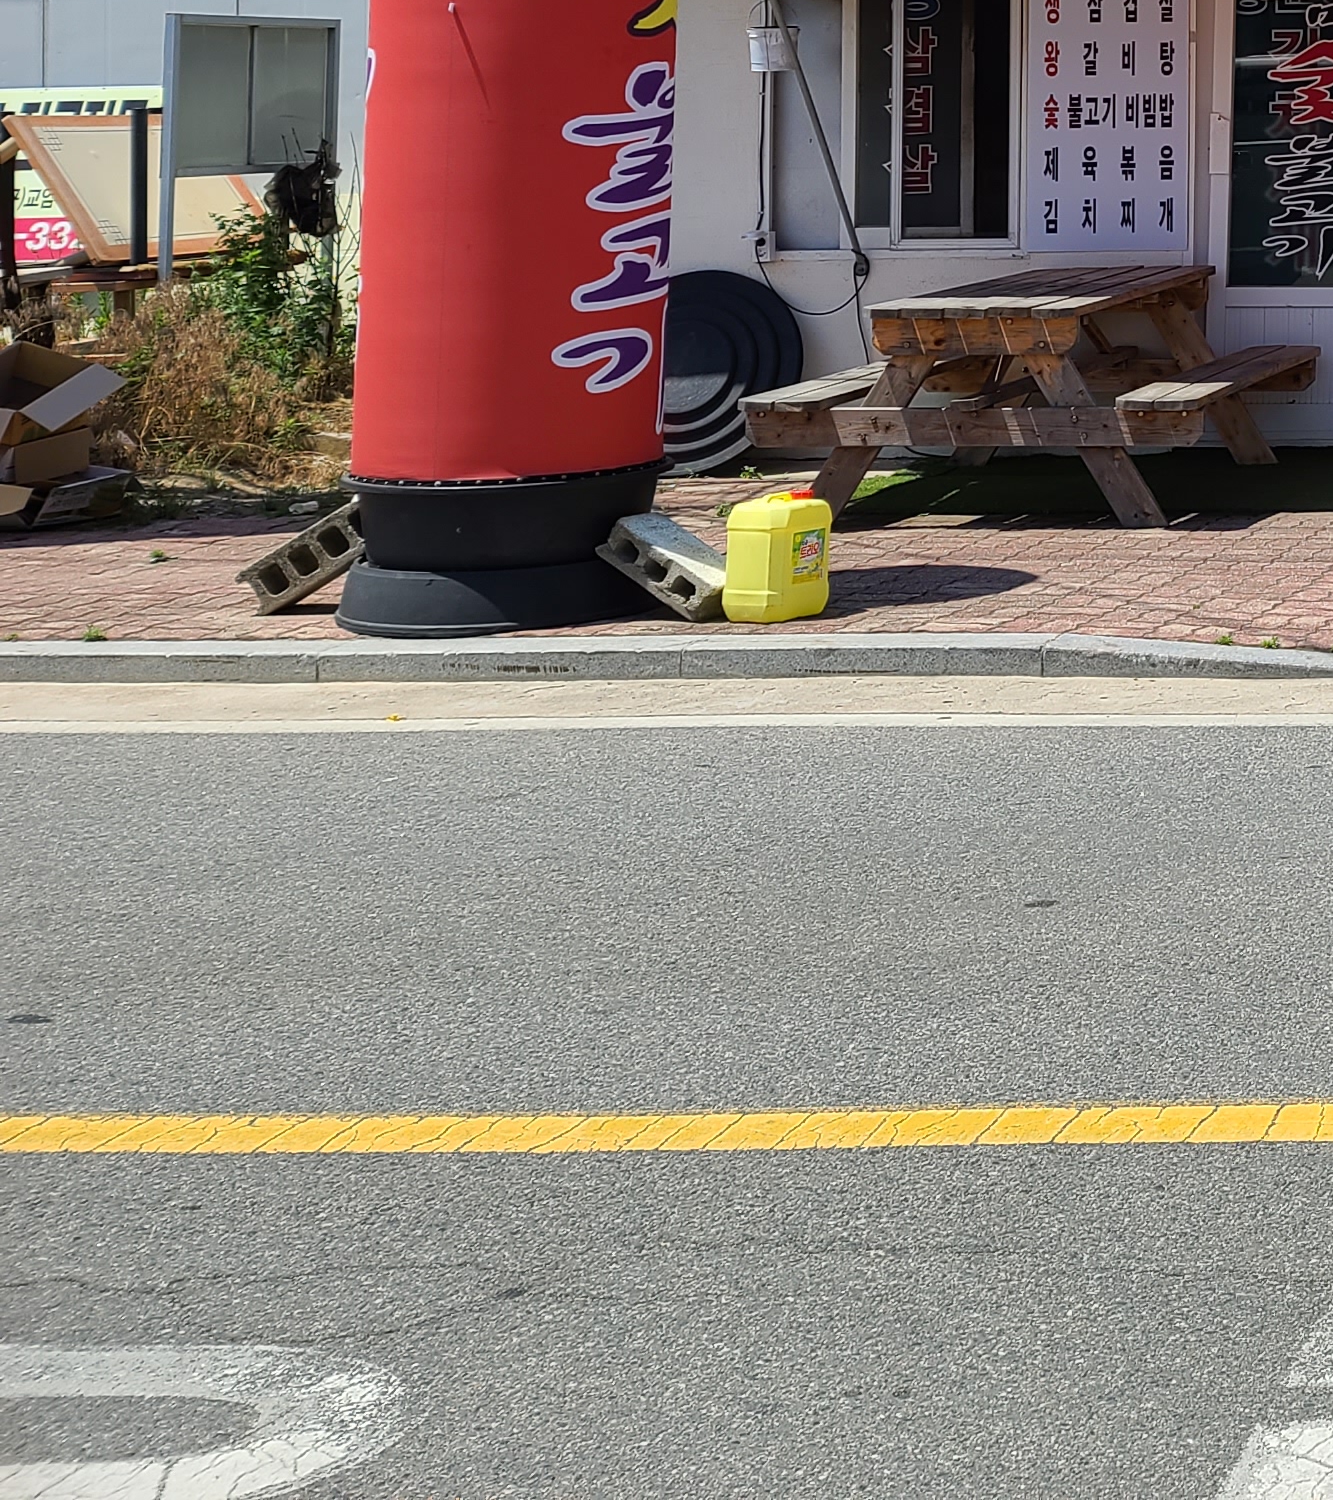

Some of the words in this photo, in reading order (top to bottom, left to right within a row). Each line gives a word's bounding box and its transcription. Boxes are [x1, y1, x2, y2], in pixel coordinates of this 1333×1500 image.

[1044, 40, 1175, 77] 왕갈비탕
[1125, 93, 1175, 128] 비빔밥
[1043, 145, 1175, 182] 제육볶음
[1043, 197, 1174, 234] 김치찌개
